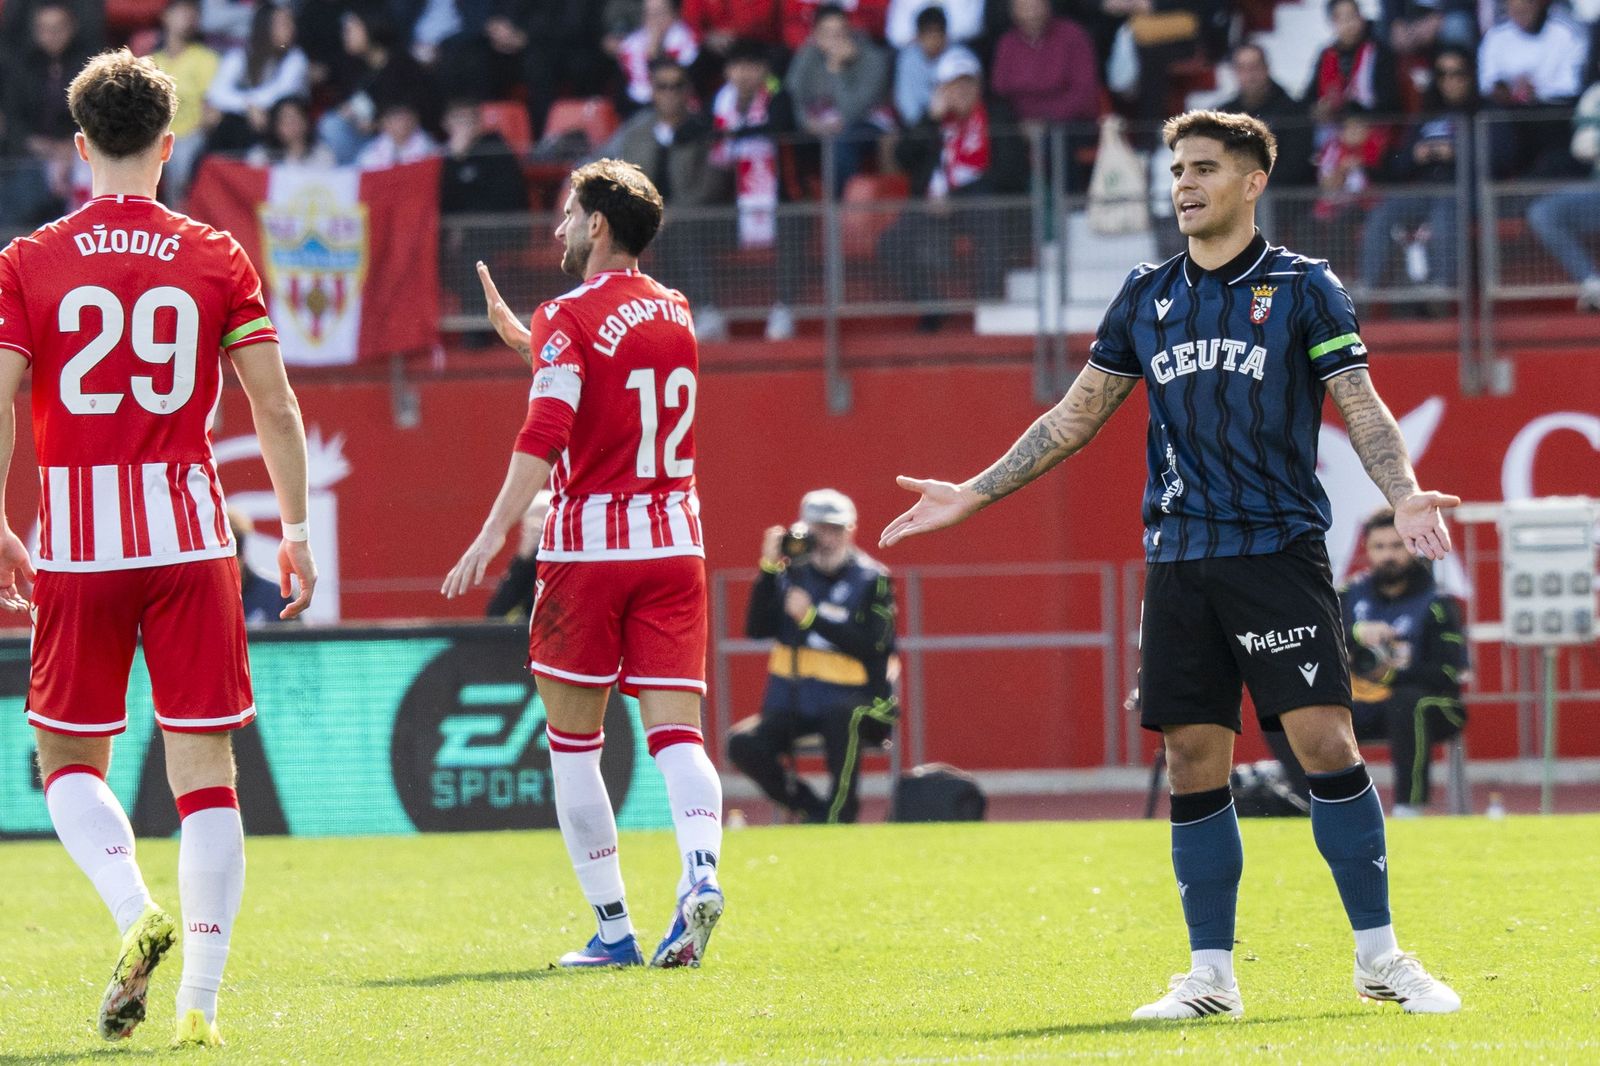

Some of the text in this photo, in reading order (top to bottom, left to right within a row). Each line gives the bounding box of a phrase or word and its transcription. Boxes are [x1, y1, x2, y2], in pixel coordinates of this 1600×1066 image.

[73, 224, 182, 262] DŽODIĆ
[593, 299, 696, 357] LEO BAPTIST
[58, 285, 199, 415] 29
[1150, 338, 1267, 384] CEUTA
[625, 367, 697, 478] 12
[1160, 479, 1180, 514] PUNTA
[1253, 625, 1317, 652] HÉLITY
[431, 768, 555, 809] SPOR
[685, 808, 717, 821] UDA
[105, 846, 131, 855] UD
[188, 922, 221, 934] UDA
